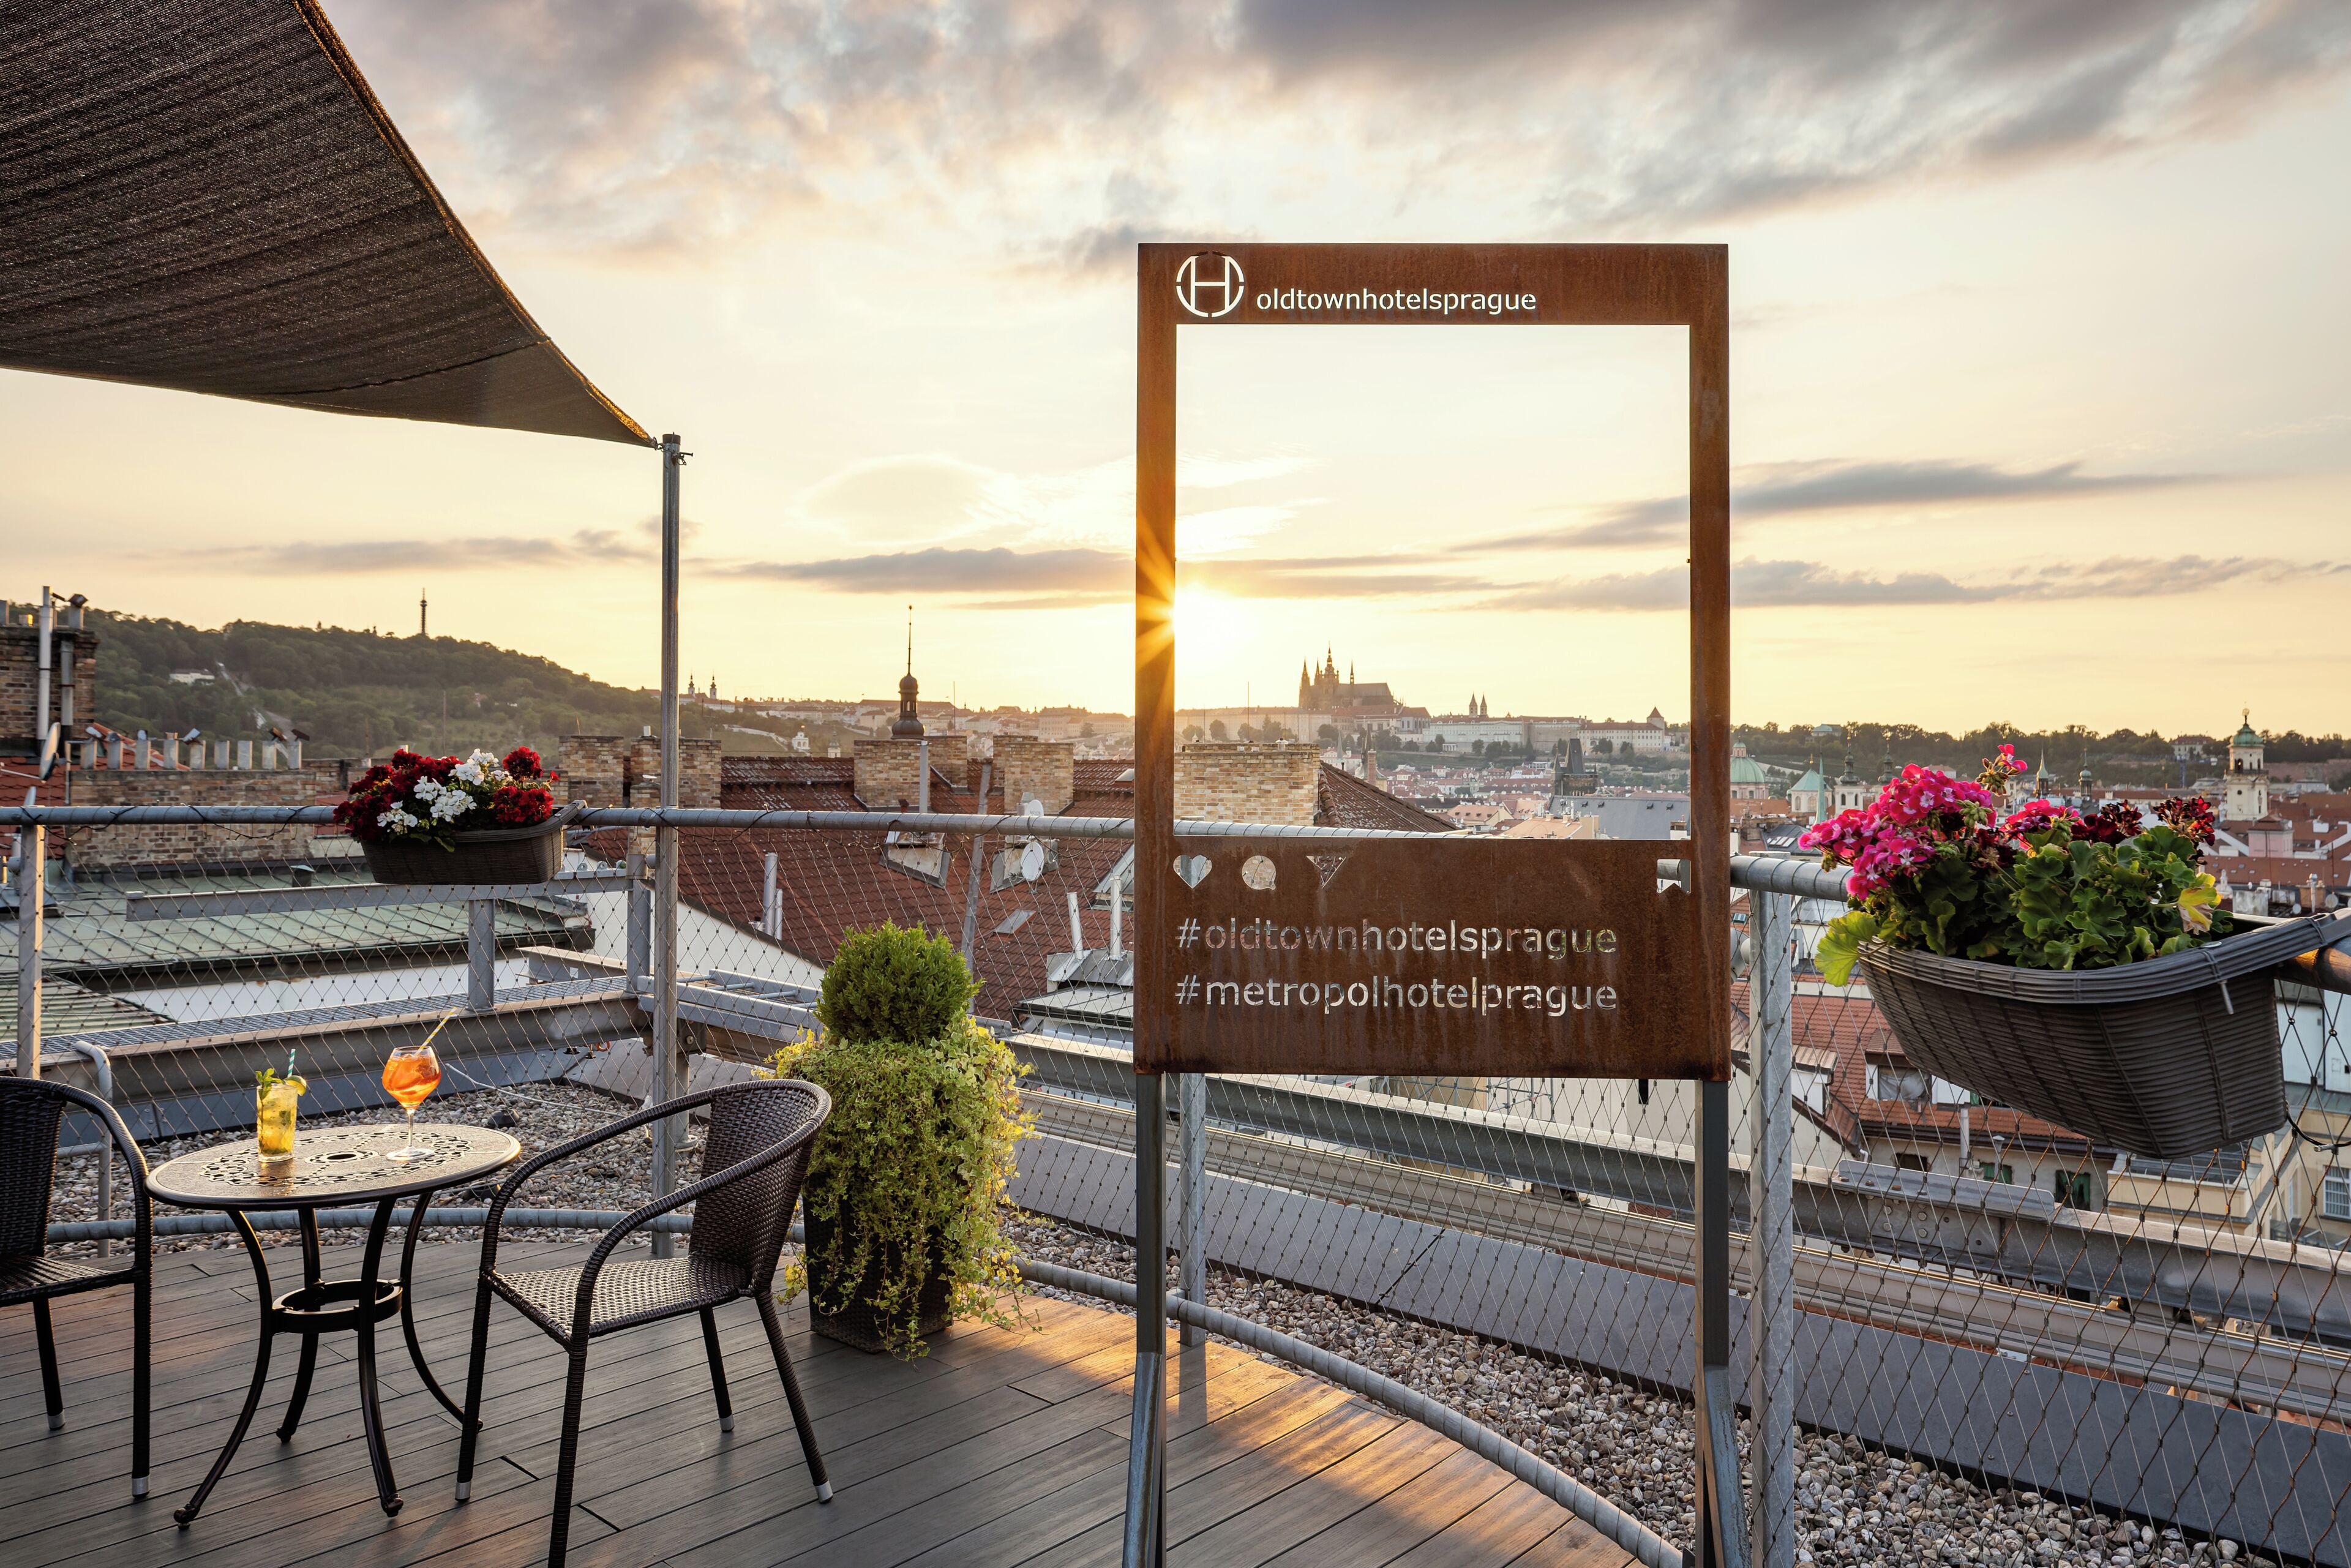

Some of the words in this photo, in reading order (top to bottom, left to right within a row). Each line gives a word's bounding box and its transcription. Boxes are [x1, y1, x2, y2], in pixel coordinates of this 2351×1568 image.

[1256, 288, 1536, 315] oldtownhotelsprague
[1176, 917, 1616, 960] #oldtownhotelsprague
[1176, 975, 1617, 1016] #metropolhotelprague
